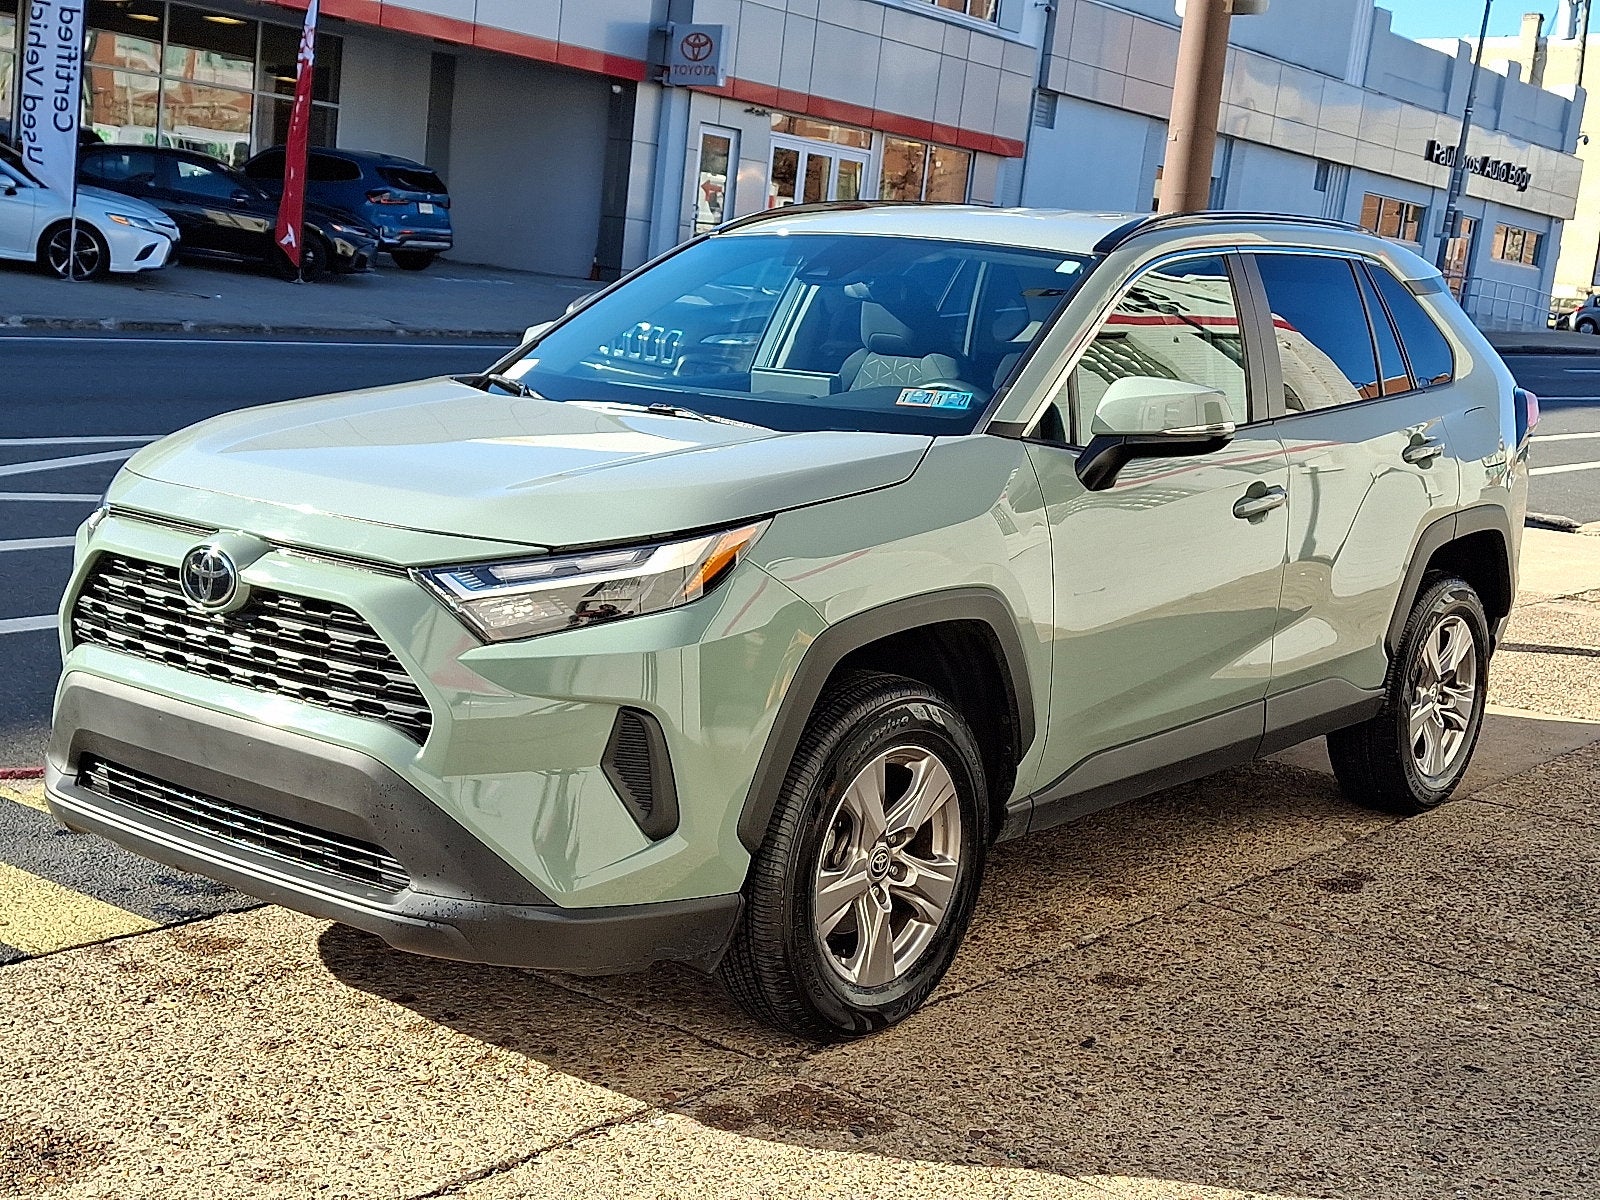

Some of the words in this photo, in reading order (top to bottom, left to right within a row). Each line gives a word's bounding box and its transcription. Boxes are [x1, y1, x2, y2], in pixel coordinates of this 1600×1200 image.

[673, 64, 716, 76] TOYOTA
[1426, 140, 1457, 168] Paul
[1483, 158, 1508, 183] Auto
[1508, 163, 1533, 192] Body
